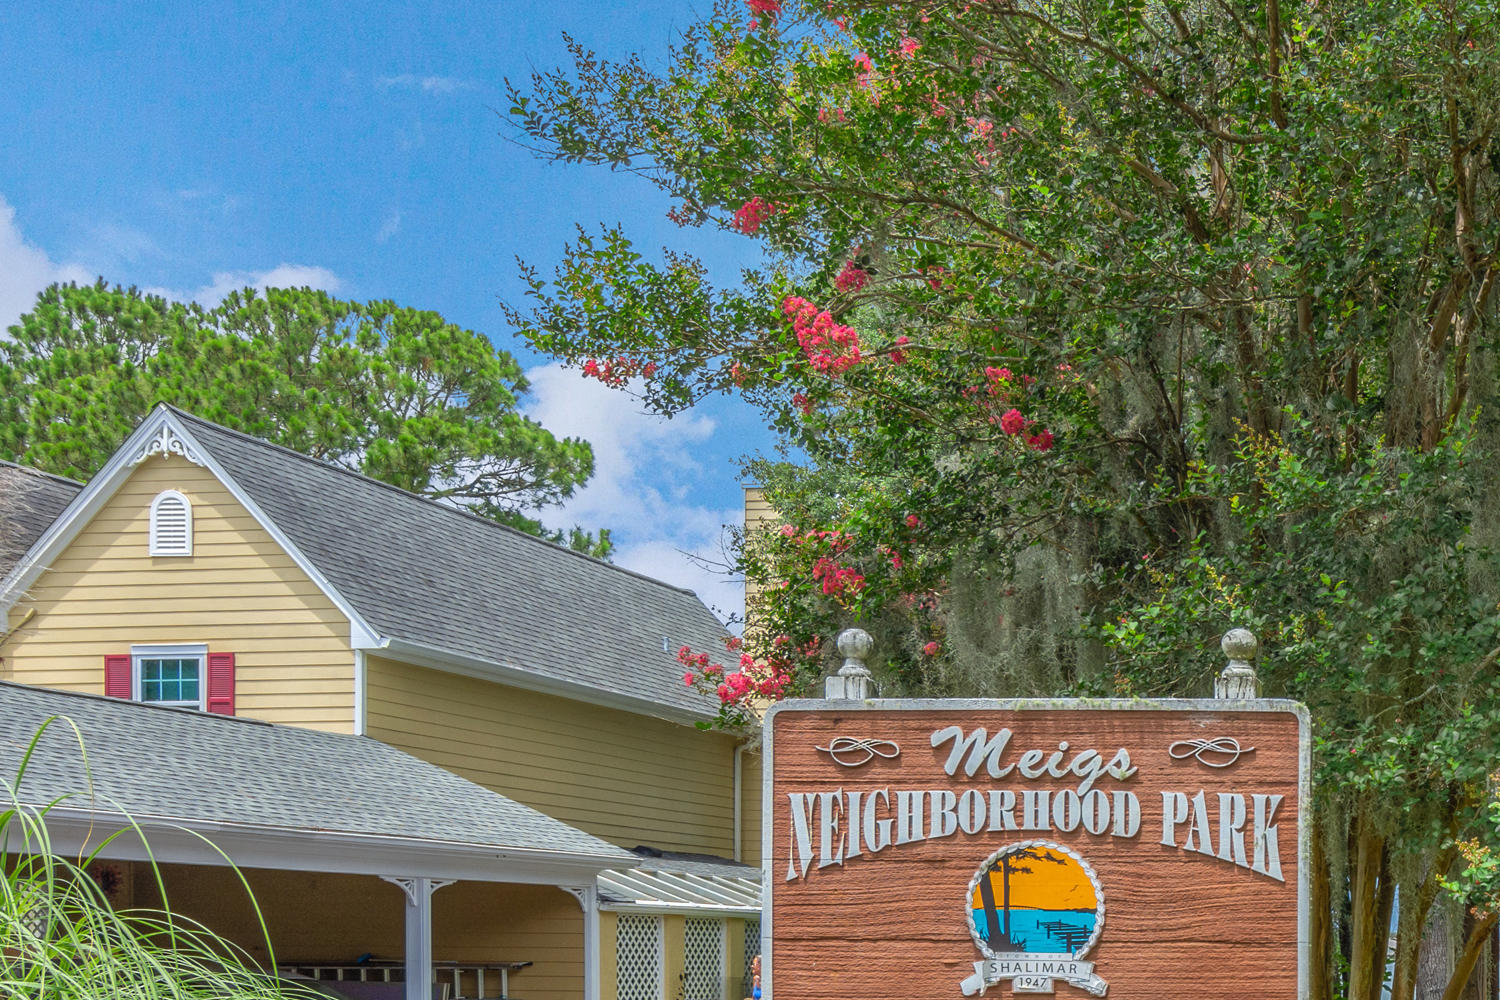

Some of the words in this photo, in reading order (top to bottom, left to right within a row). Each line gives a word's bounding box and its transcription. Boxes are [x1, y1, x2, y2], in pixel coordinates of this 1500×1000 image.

[931, 726, 1138, 796] Meigs
[786, 787, 1142, 882] NEIGHBORHOOD
[1160, 789, 1286, 883] PARK
[990, 962, 1078, 974] SHALIMAR
[1019, 977, 1048, 988] 1947
